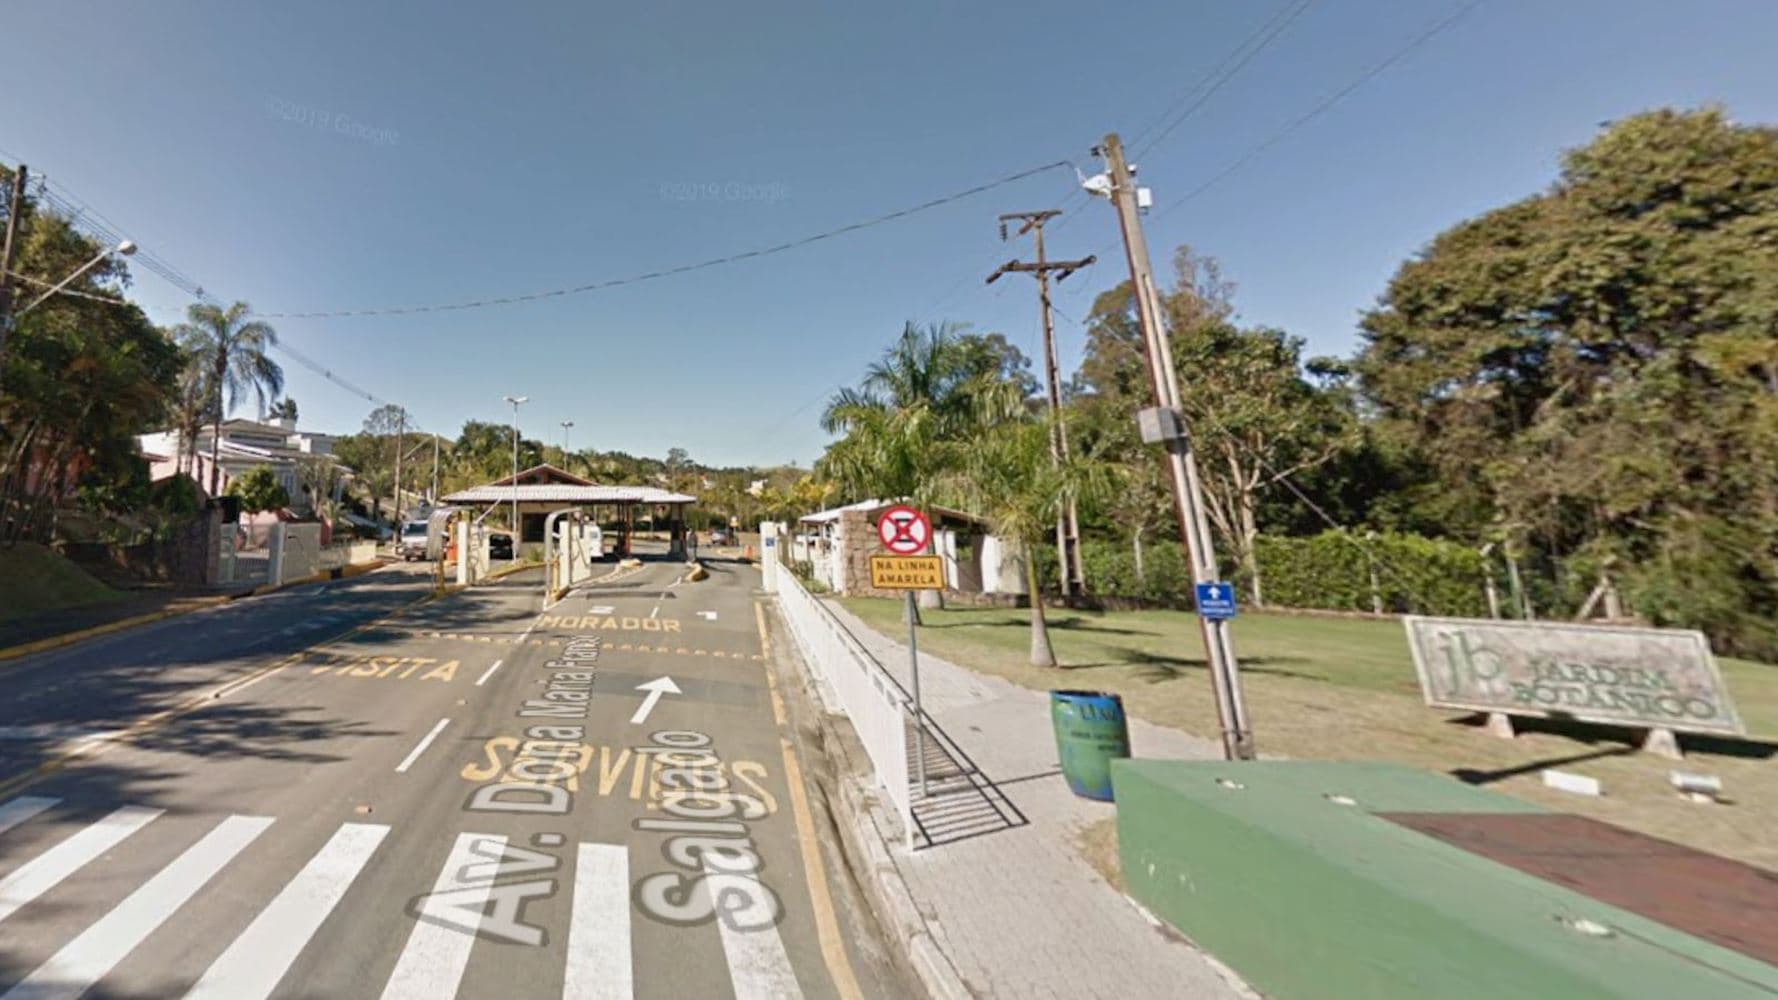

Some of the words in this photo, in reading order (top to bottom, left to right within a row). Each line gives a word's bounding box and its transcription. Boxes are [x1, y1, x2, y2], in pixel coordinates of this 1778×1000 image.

[876, 561, 893, 570] NA
[898, 561, 935, 570] LINHA
[878, 574, 936, 585] AMARELA
[540, 615, 681, 632] MORADOR
